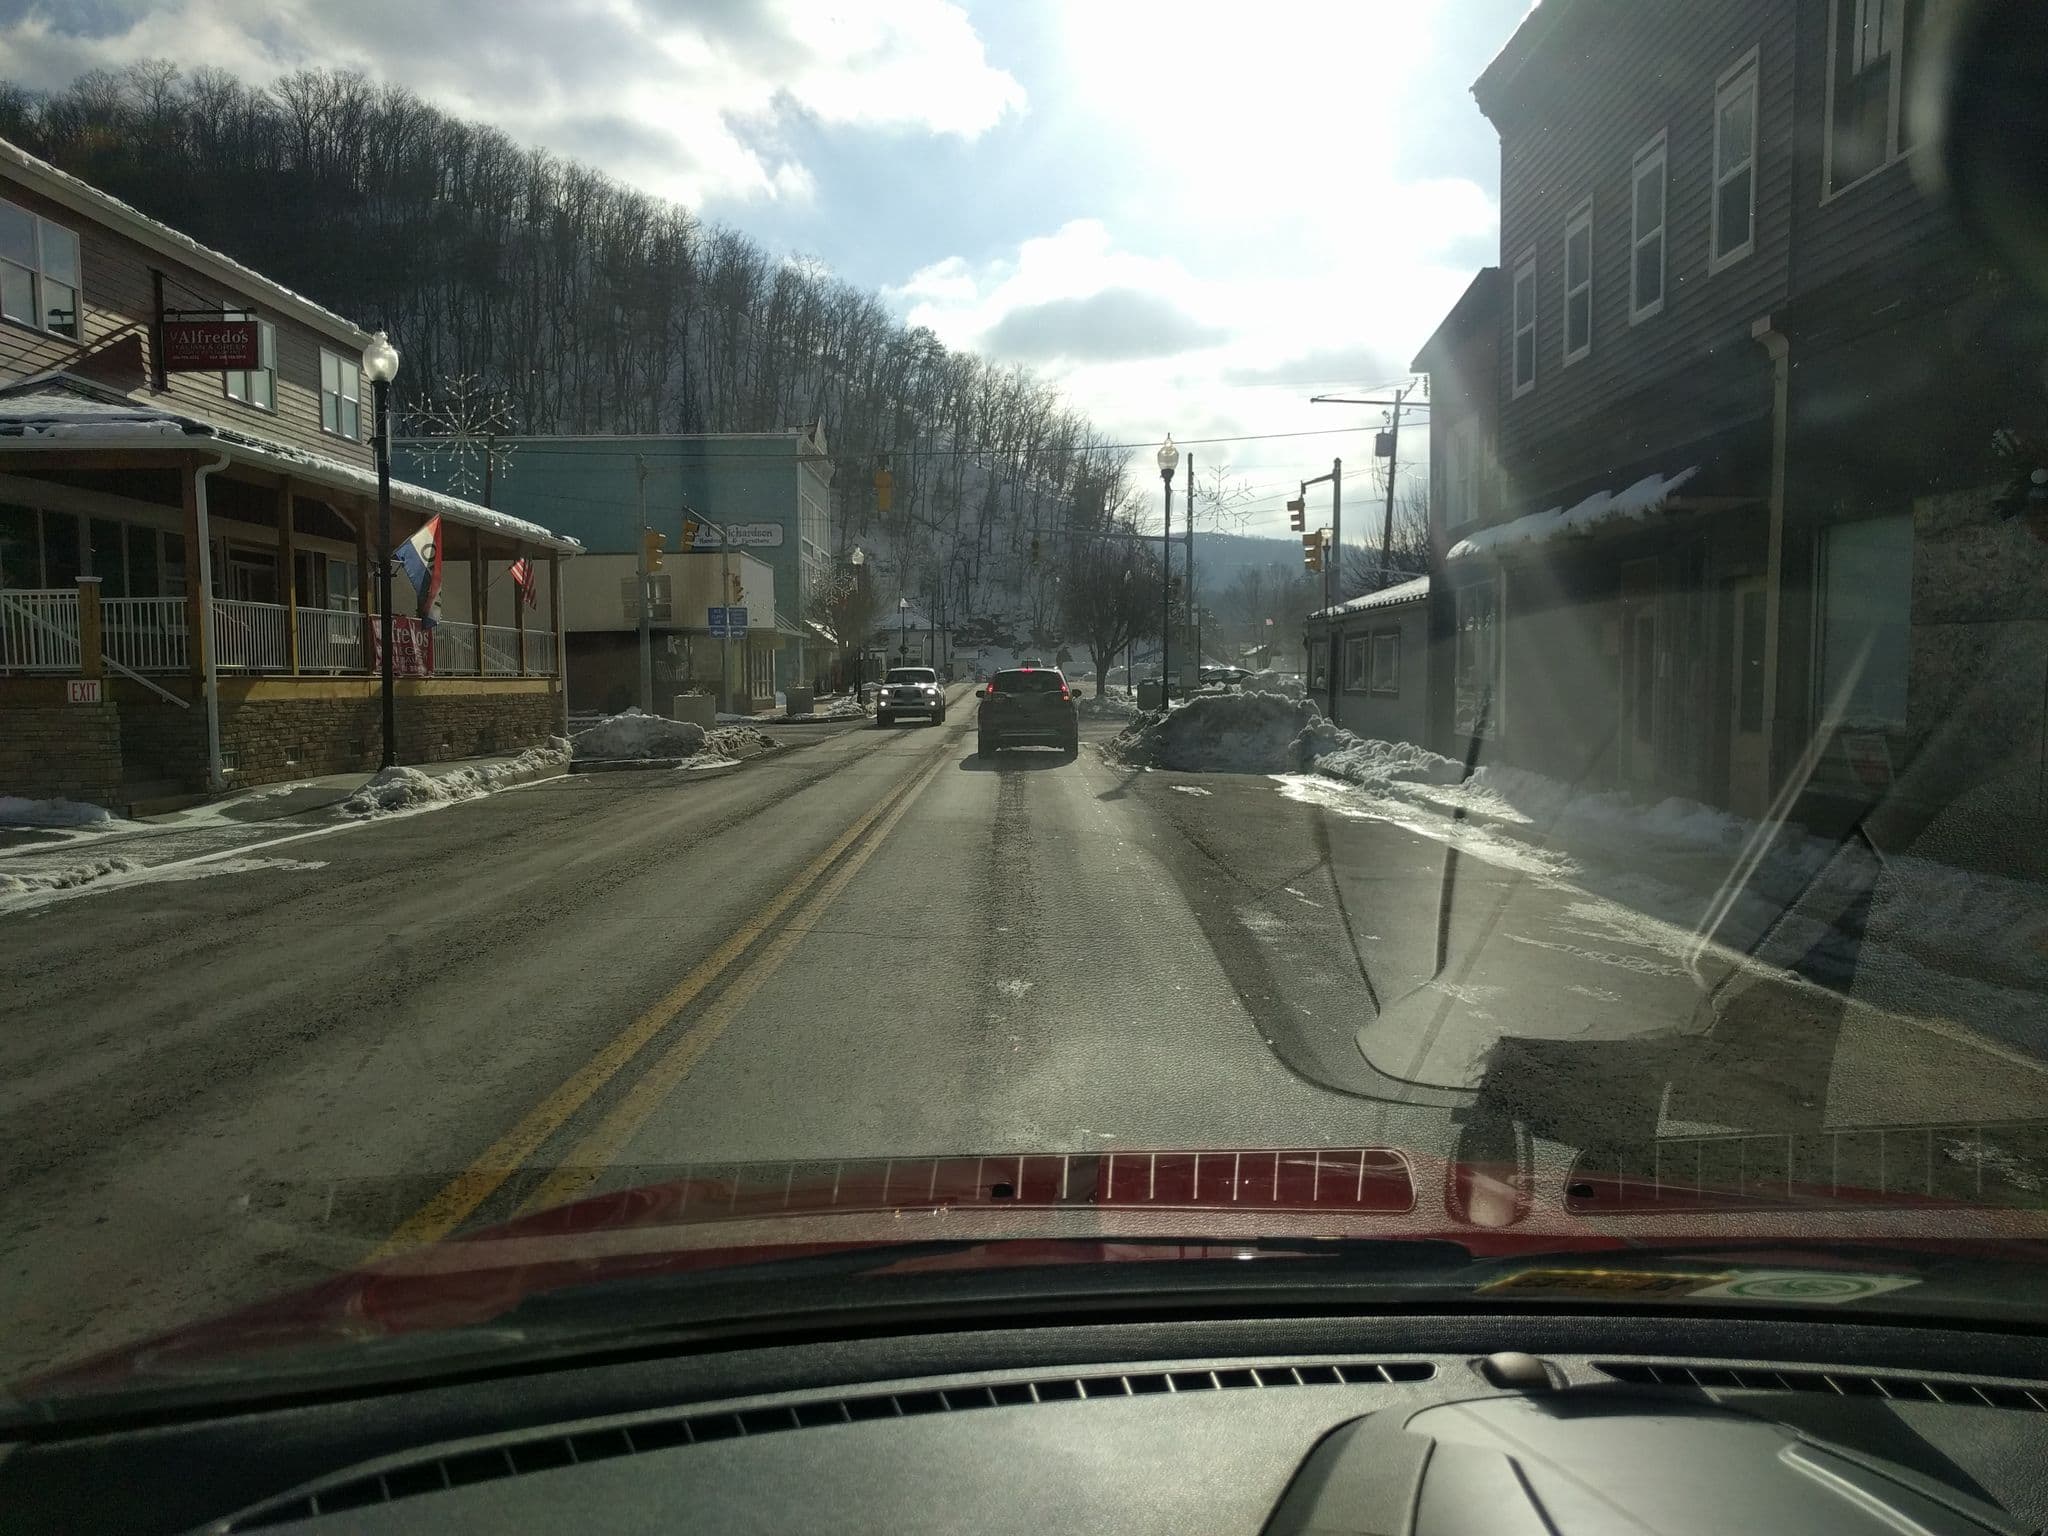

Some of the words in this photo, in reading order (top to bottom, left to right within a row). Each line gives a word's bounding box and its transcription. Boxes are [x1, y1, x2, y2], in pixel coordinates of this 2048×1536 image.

[179, 329, 249, 344] Alfredo's
[724, 527, 773, 538] ichardson
[72, 682, 97, 701] EXIT
